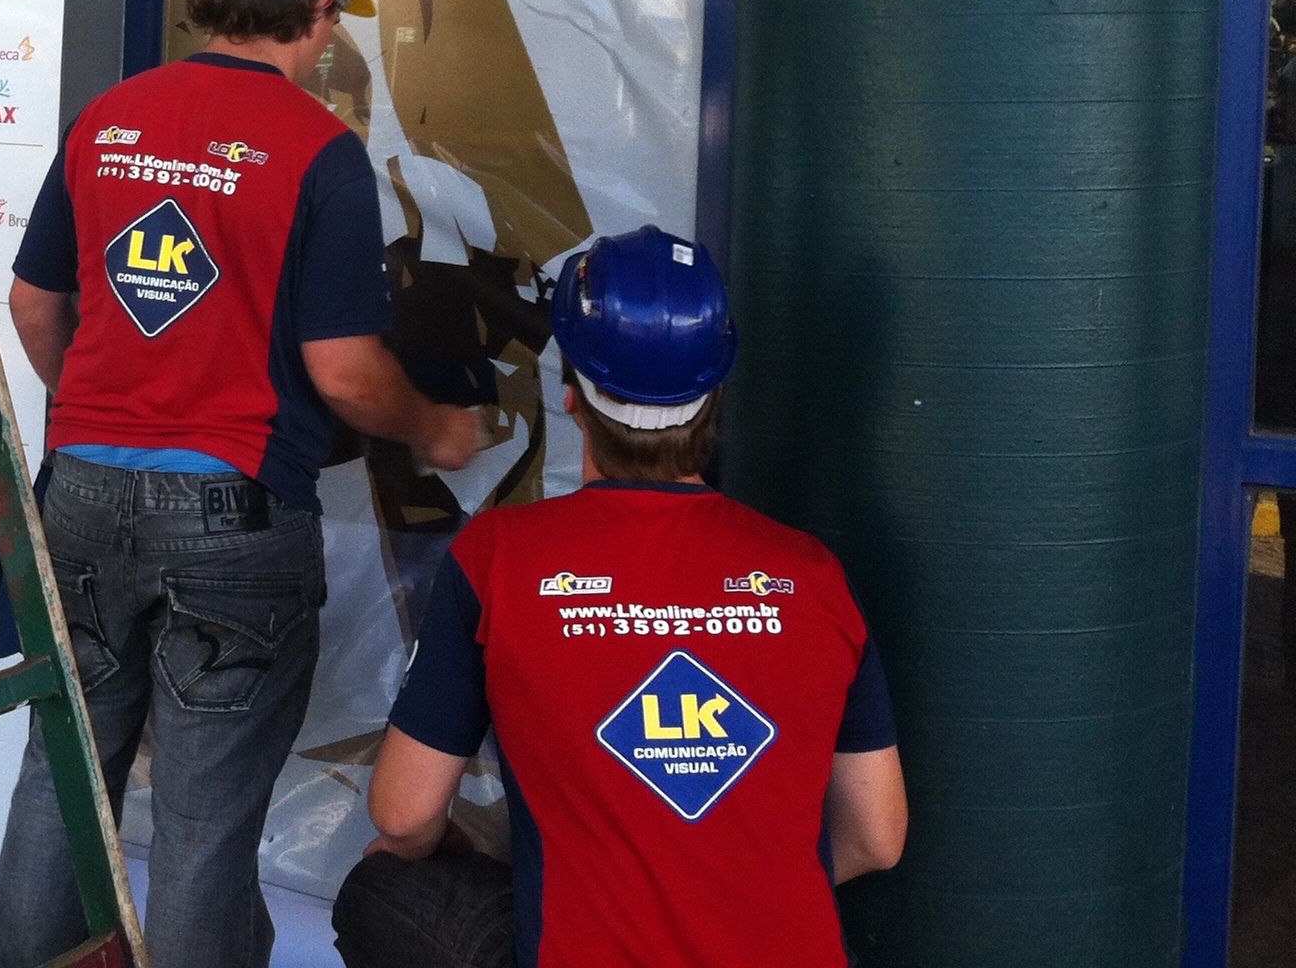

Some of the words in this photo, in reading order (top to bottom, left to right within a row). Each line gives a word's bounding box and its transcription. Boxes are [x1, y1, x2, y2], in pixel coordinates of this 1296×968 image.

[8, 214, 29, 228] Bra
[127, 230, 195, 274] LK
[116, 273, 200, 292] COMUNICAÇÃO
[136, 288, 177, 302] VISUAL
[723, 572, 795, 595] LOKAR
[559, 603, 780, 620] www.LKonline.com.br
[562, 622, 606, 638] (51)
[613, 619, 783, 635] 3592-0000
[642, 693, 731, 739] LK
[633, 743, 748, 760] COMUNICAÇÃO
[664, 762, 719, 774] VISUAL
